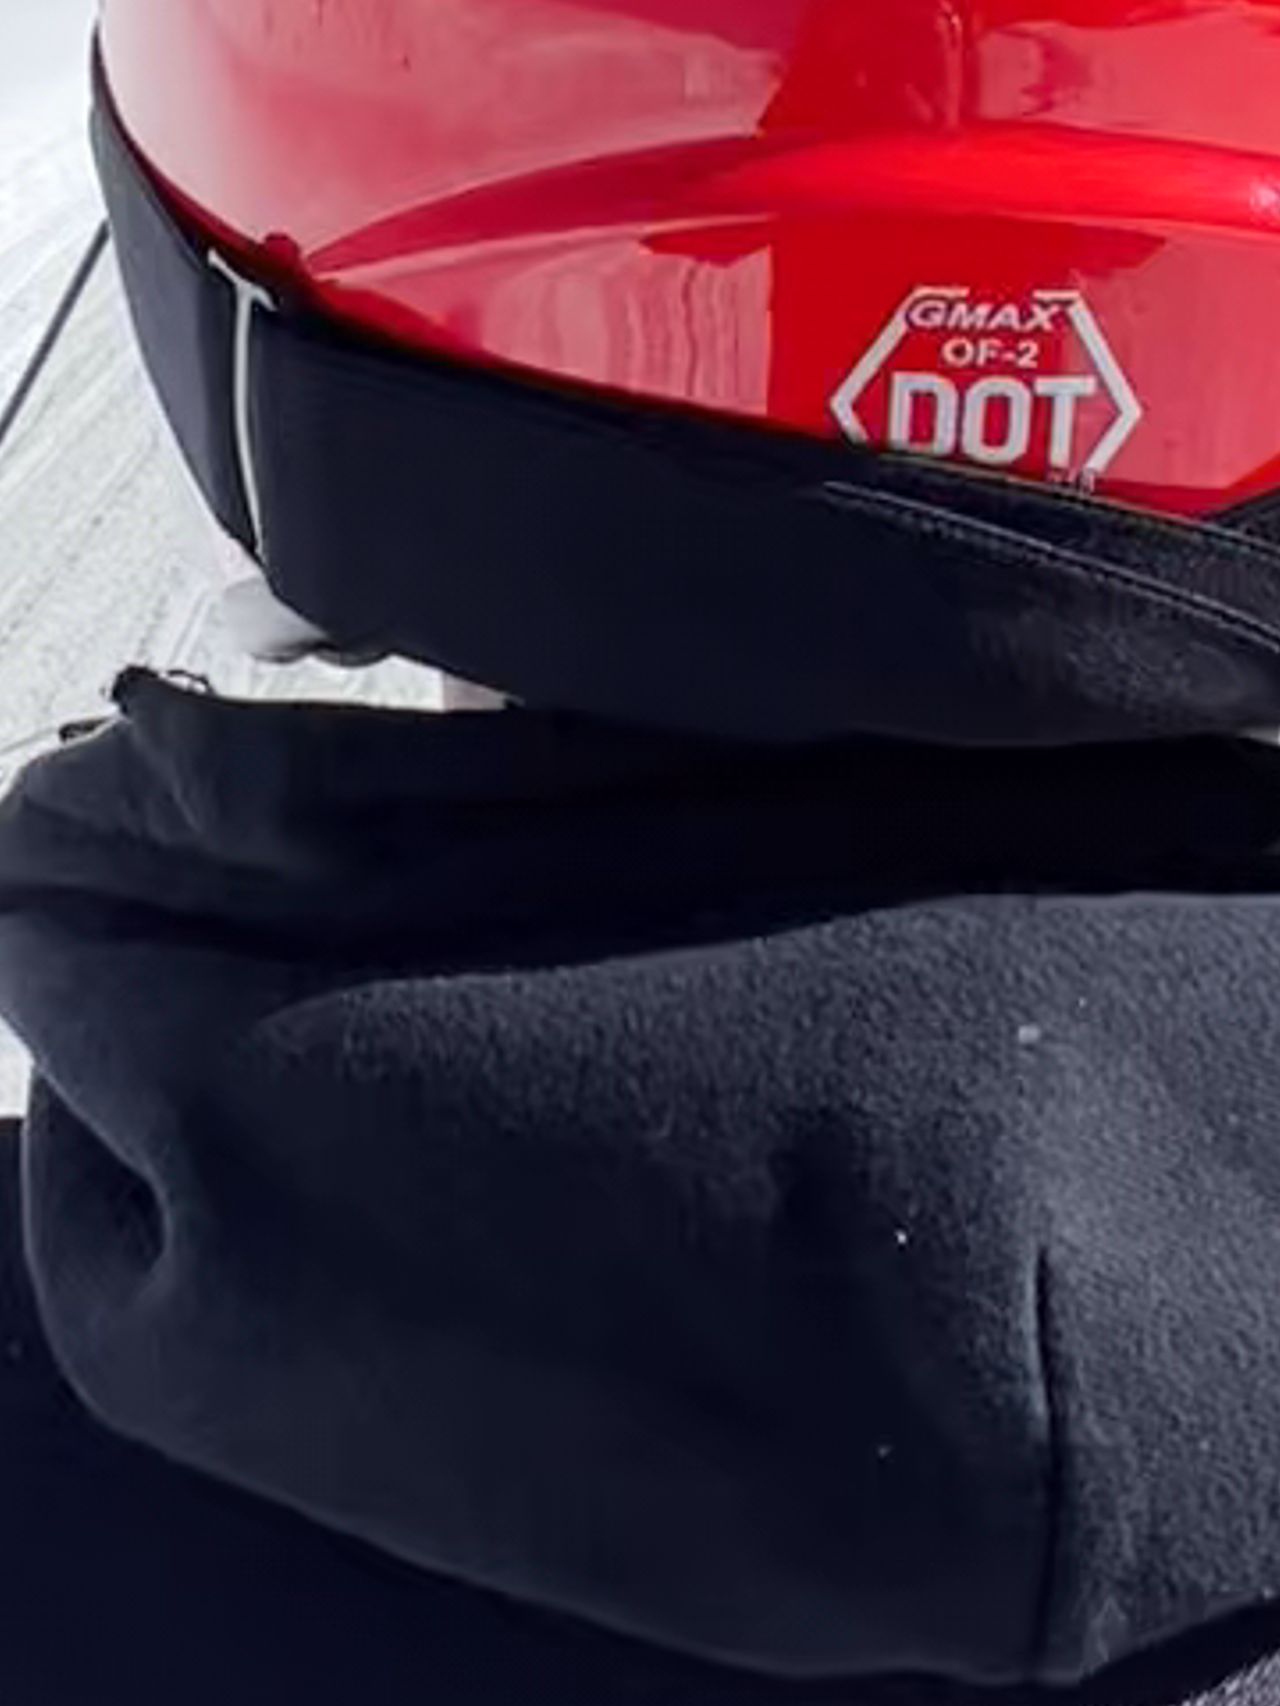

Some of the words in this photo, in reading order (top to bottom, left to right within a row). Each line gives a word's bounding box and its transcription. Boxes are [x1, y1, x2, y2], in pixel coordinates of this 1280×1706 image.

[907, 299, 1061, 331] GMAX
[941, 338, 1040, 368] OF-2
[888, 371, 1097, 468] DOT
